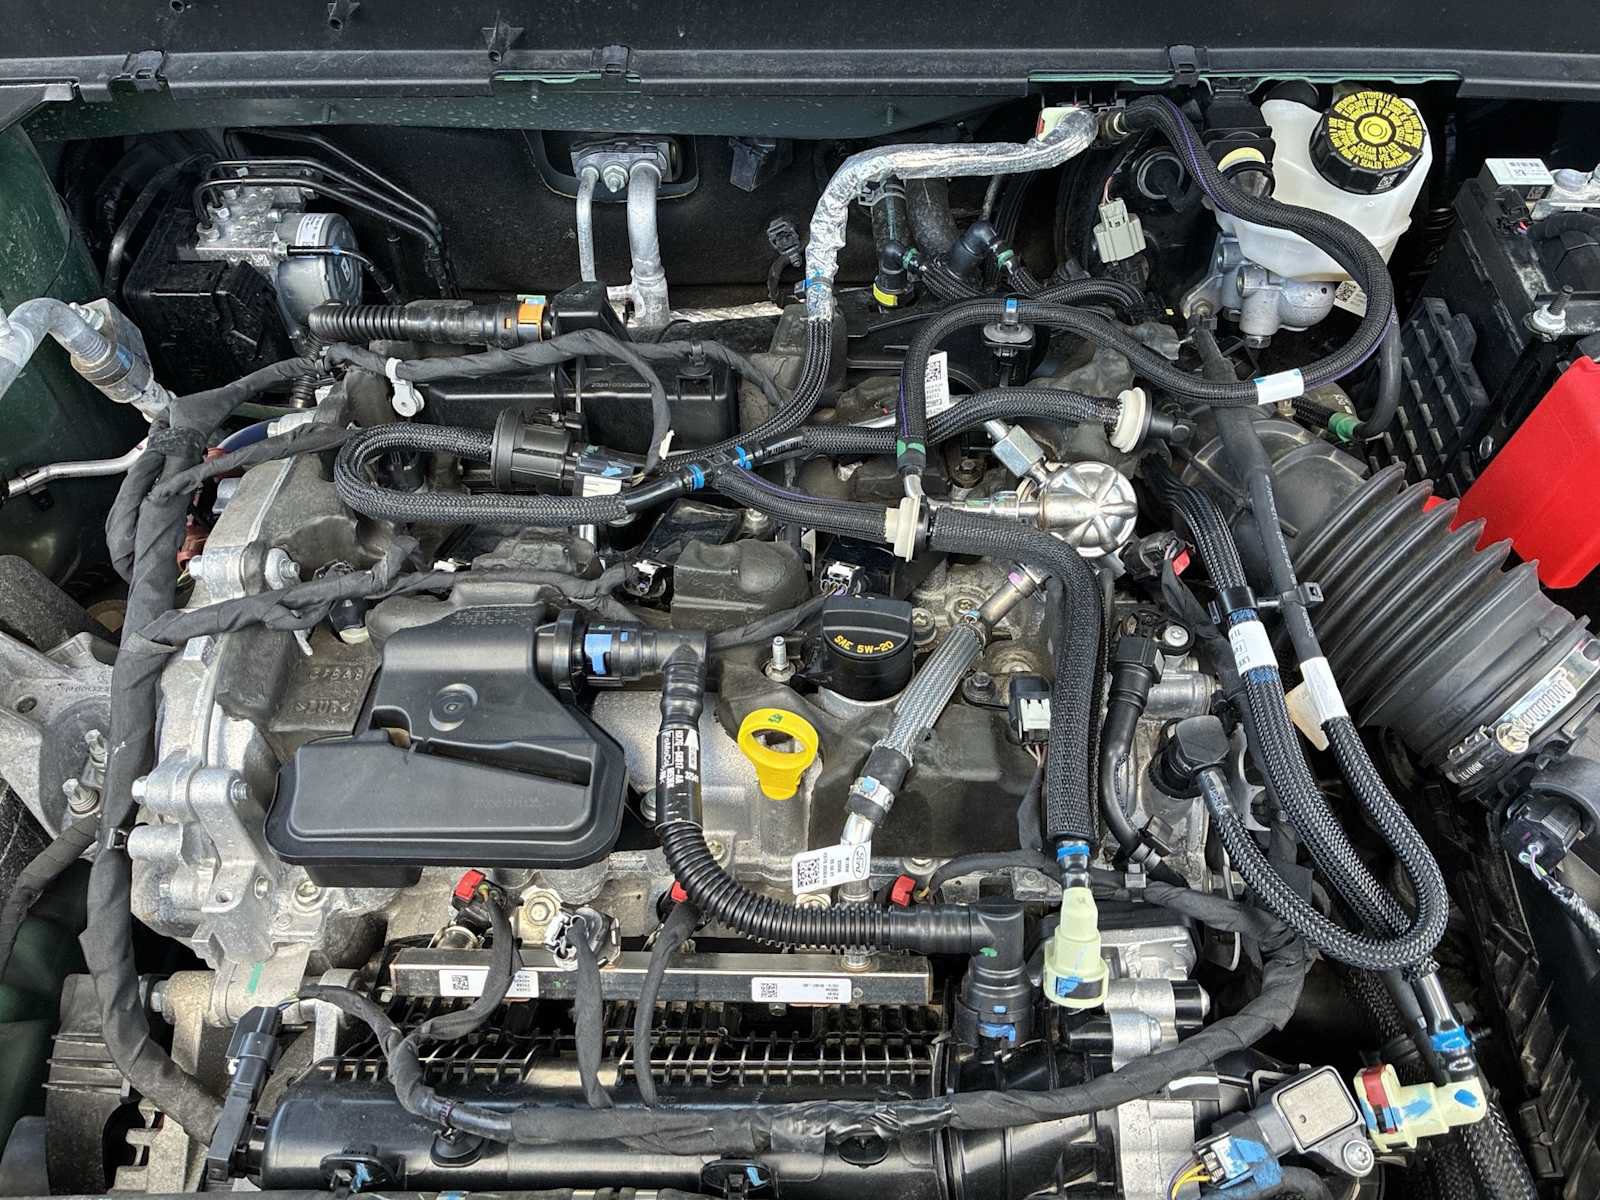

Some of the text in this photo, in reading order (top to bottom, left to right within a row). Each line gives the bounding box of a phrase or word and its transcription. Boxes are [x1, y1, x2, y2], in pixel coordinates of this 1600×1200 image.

[1356, 142, 1401, 155] CLEAN FILLER
[1359, 159, 1382, 169] SEALED
[834, 635, 894, 654] SAE 5W-20
